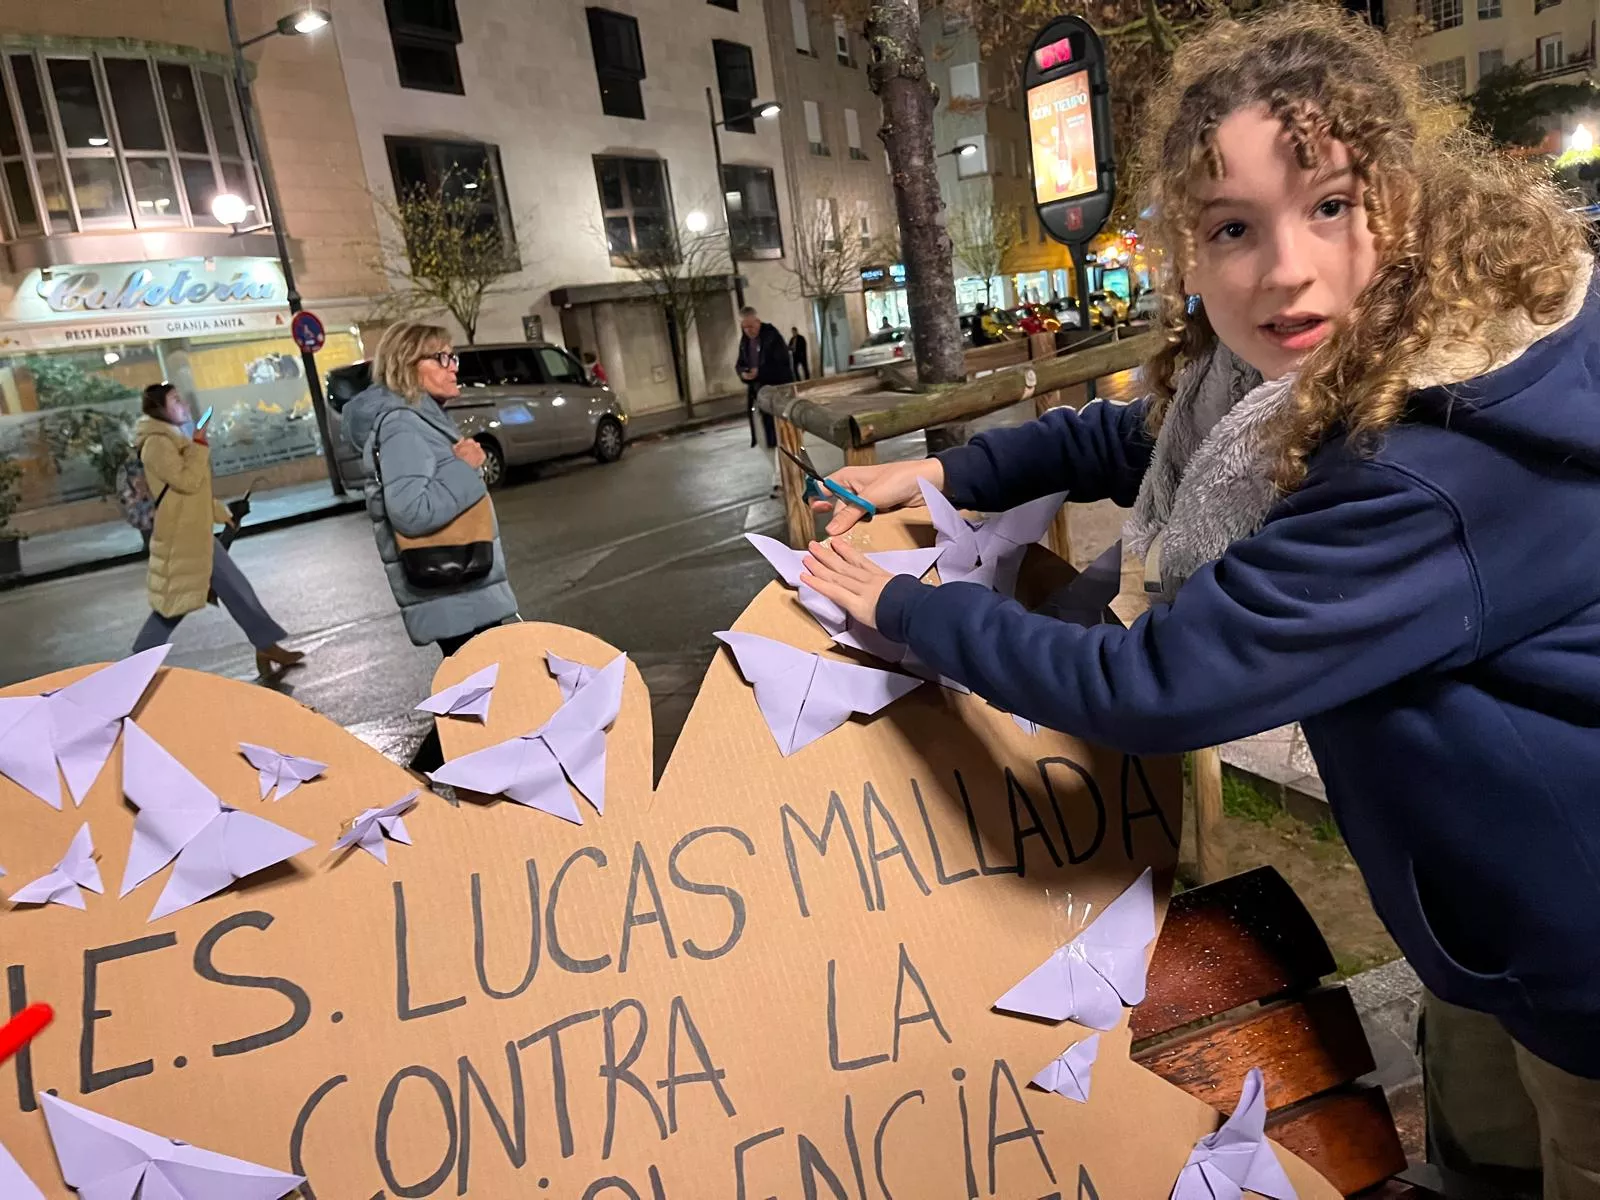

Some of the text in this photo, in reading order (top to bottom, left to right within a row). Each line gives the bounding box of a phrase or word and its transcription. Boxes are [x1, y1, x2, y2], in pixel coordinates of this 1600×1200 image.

[65, 325, 150, 341] RESTAURANTE
[7, 753, 1180, 1112] I.E.S. LUCAS MALLADA
[289, 943, 952, 1200] CONTRA LA
